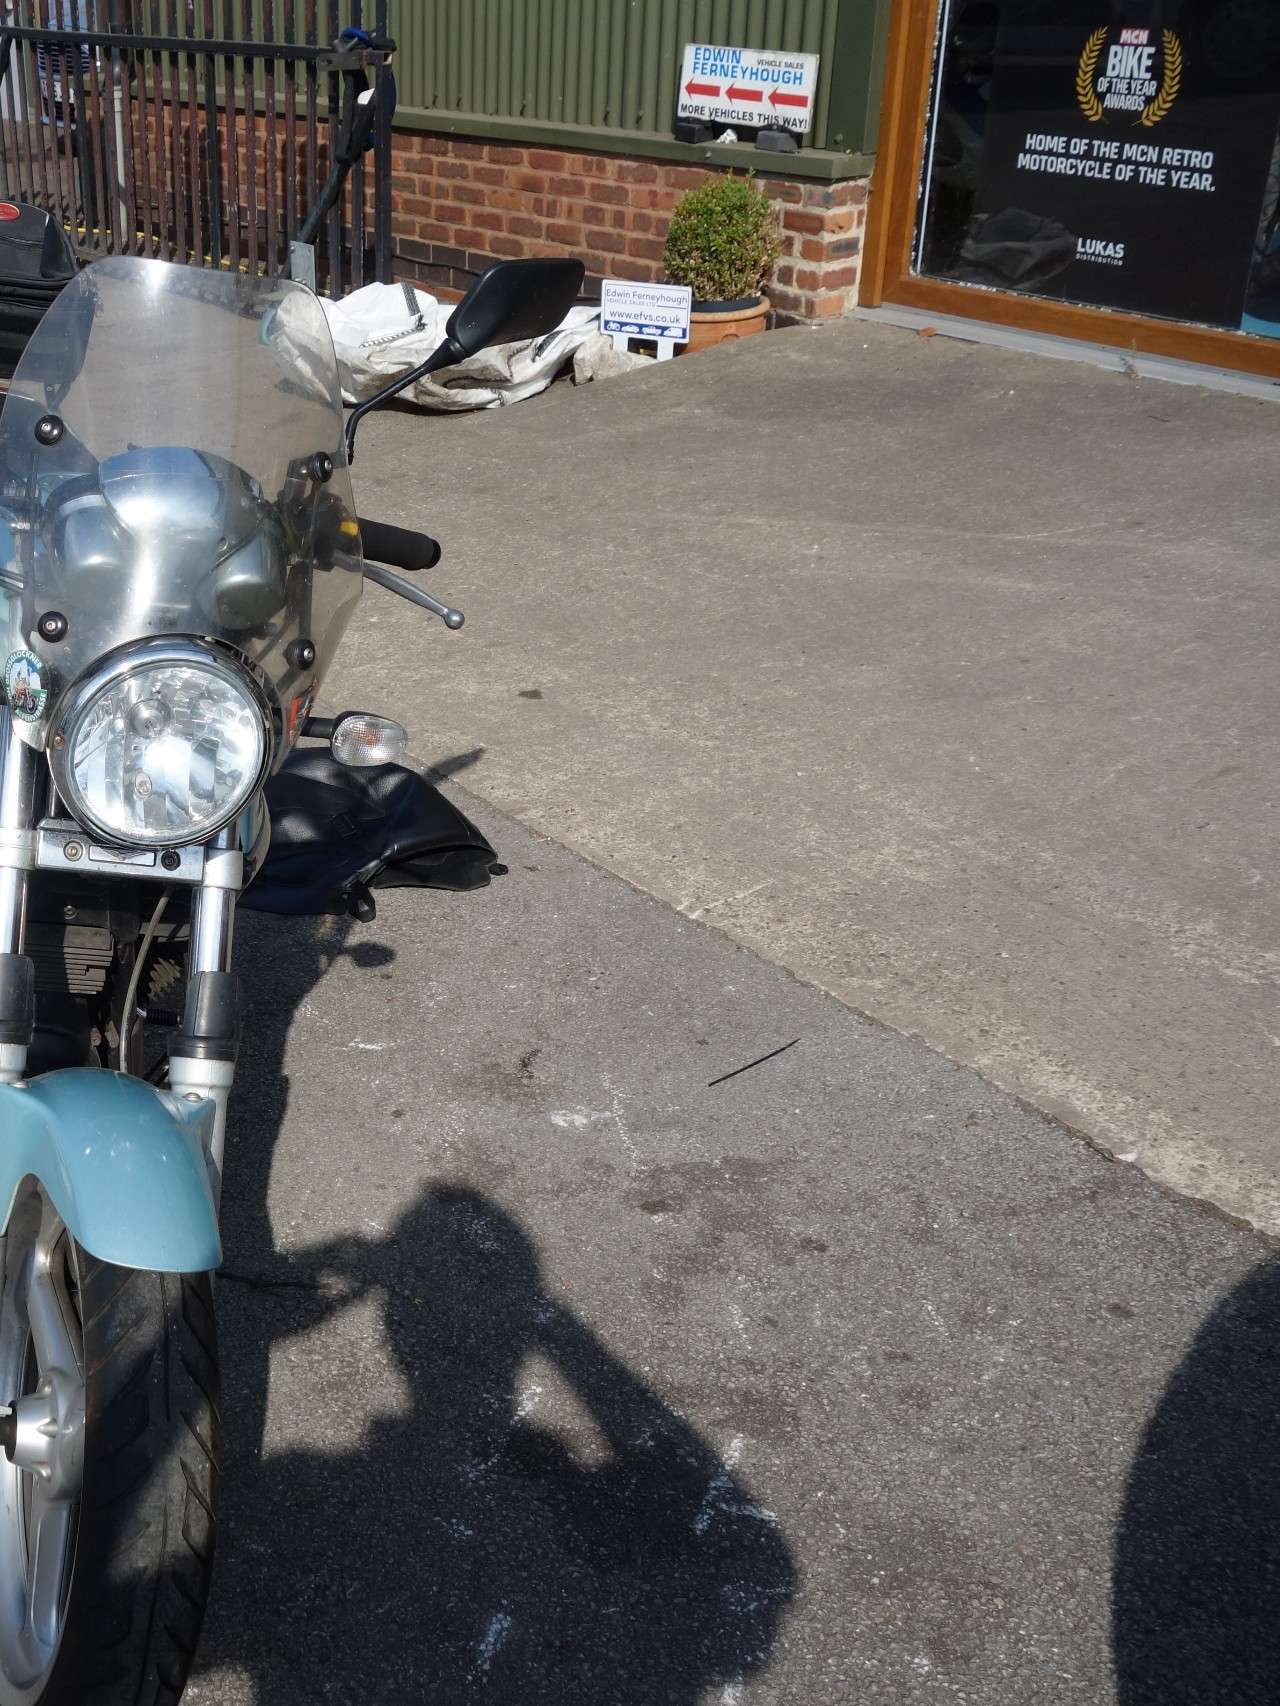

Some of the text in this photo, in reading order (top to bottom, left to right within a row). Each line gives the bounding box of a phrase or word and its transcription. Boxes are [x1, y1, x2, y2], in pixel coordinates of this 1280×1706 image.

[1120, 29, 1149, 45] MCN
[694, 47, 742, 64] EDWIN
[757, 58, 804, 70] VEHICLE SALES
[1106, 45, 1156, 80] BIKE
[692, 61, 804, 86] FERNEYHOUGH
[1097, 77, 1158, 97] OF THE YEAR
[1103, 93, 1146, 111] AWARDS
[680, 103, 808, 130] MORE VEHICLES THIS WAY!
[1025, 133, 1214, 169] HOME OF THE MCN RETRO
[1017, 152, 1217, 192] MOTORCYCLE OF THE YEAR.
[1076, 237, 1125, 259] LUKAS
[606, 289, 688, 306] Edwin Ferneyhough
[609, 310, 681, 324] www.efvs.co.uk
